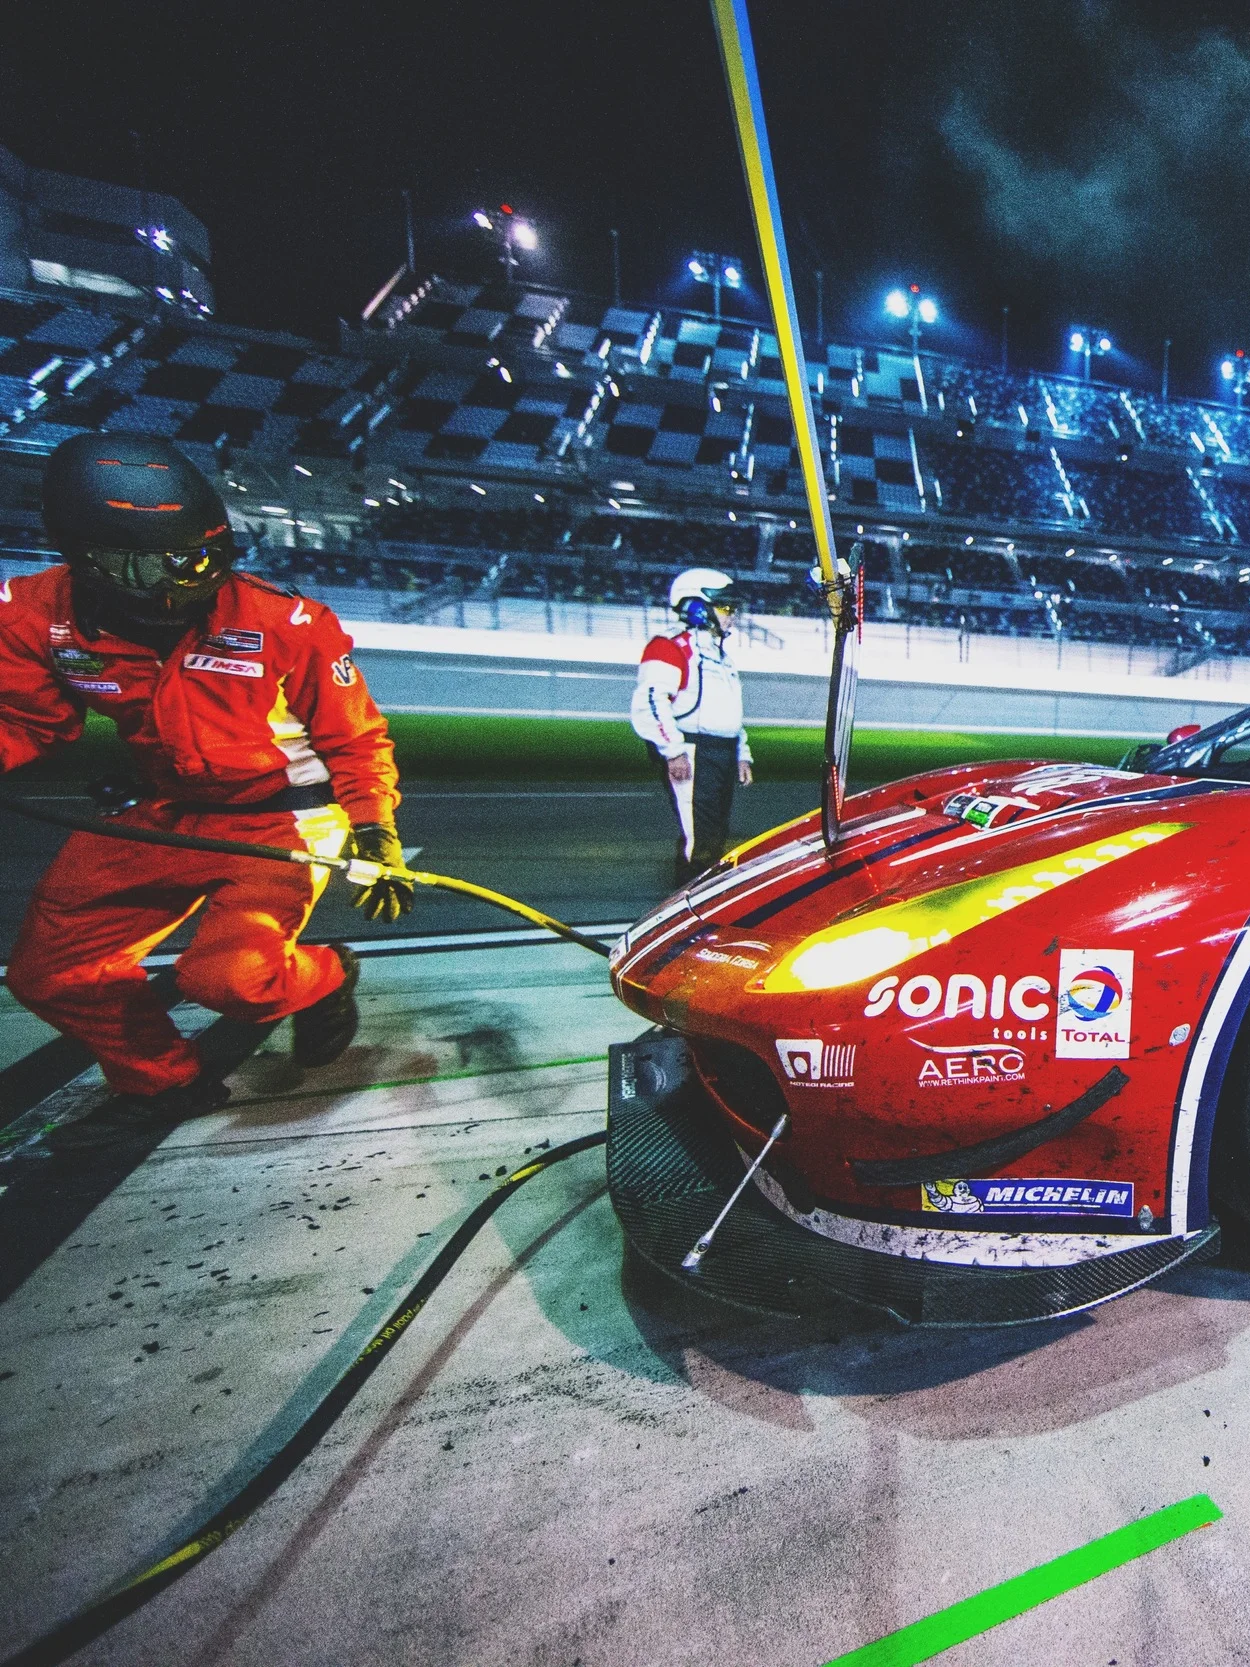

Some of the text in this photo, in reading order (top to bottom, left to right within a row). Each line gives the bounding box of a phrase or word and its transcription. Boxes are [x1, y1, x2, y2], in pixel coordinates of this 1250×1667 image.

[211, 660, 257, 675] IMSA
[993, 1026, 1048, 1041] tools
[1061, 1028, 1126, 1043] TOTAL
[918, 1053, 1024, 1080] AERO
[918, 1073, 1026, 1088] WWW.RETHINKPAINT.COM
[985, 1185, 1129, 1205] MICHELIN
